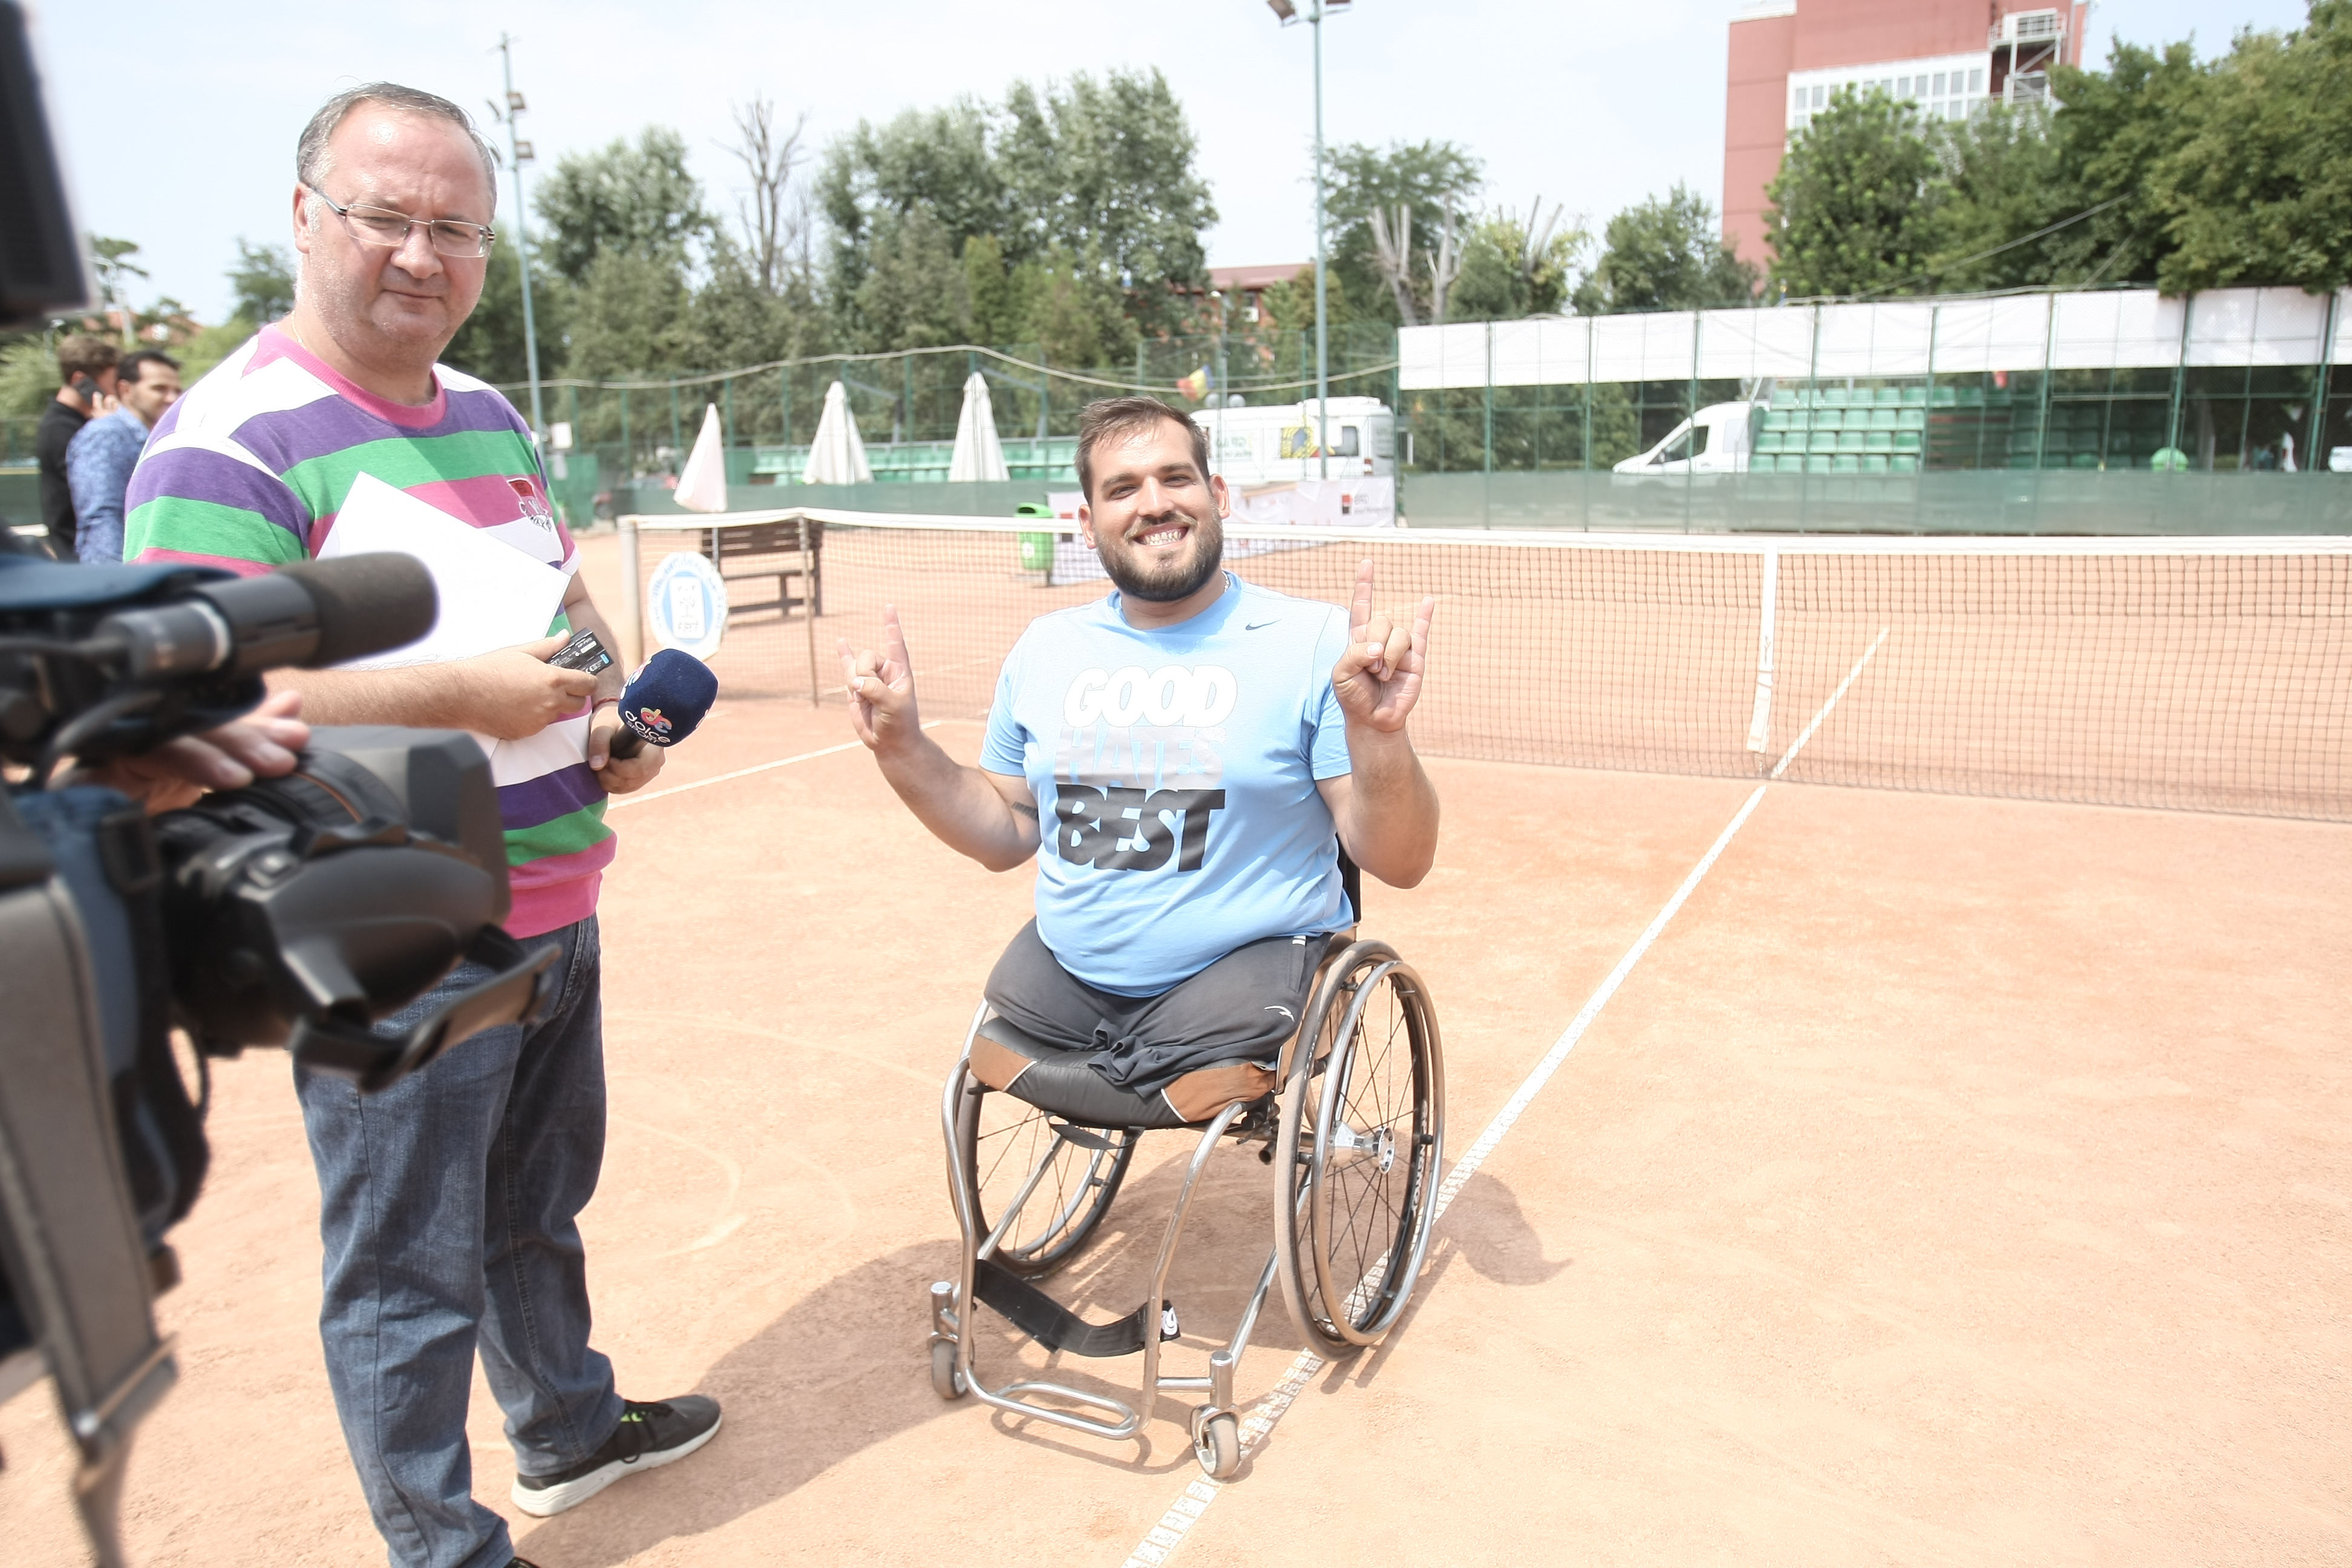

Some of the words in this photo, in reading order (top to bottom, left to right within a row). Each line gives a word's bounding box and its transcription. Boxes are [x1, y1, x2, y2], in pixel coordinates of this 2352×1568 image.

[625, 710, 671, 743] dolce
[1063, 664, 1238, 728] GOOD
[627, 720, 659, 743] SPORT
[1054, 725, 1227, 790] HATES
[1056, 784, 1226, 872] BEST
